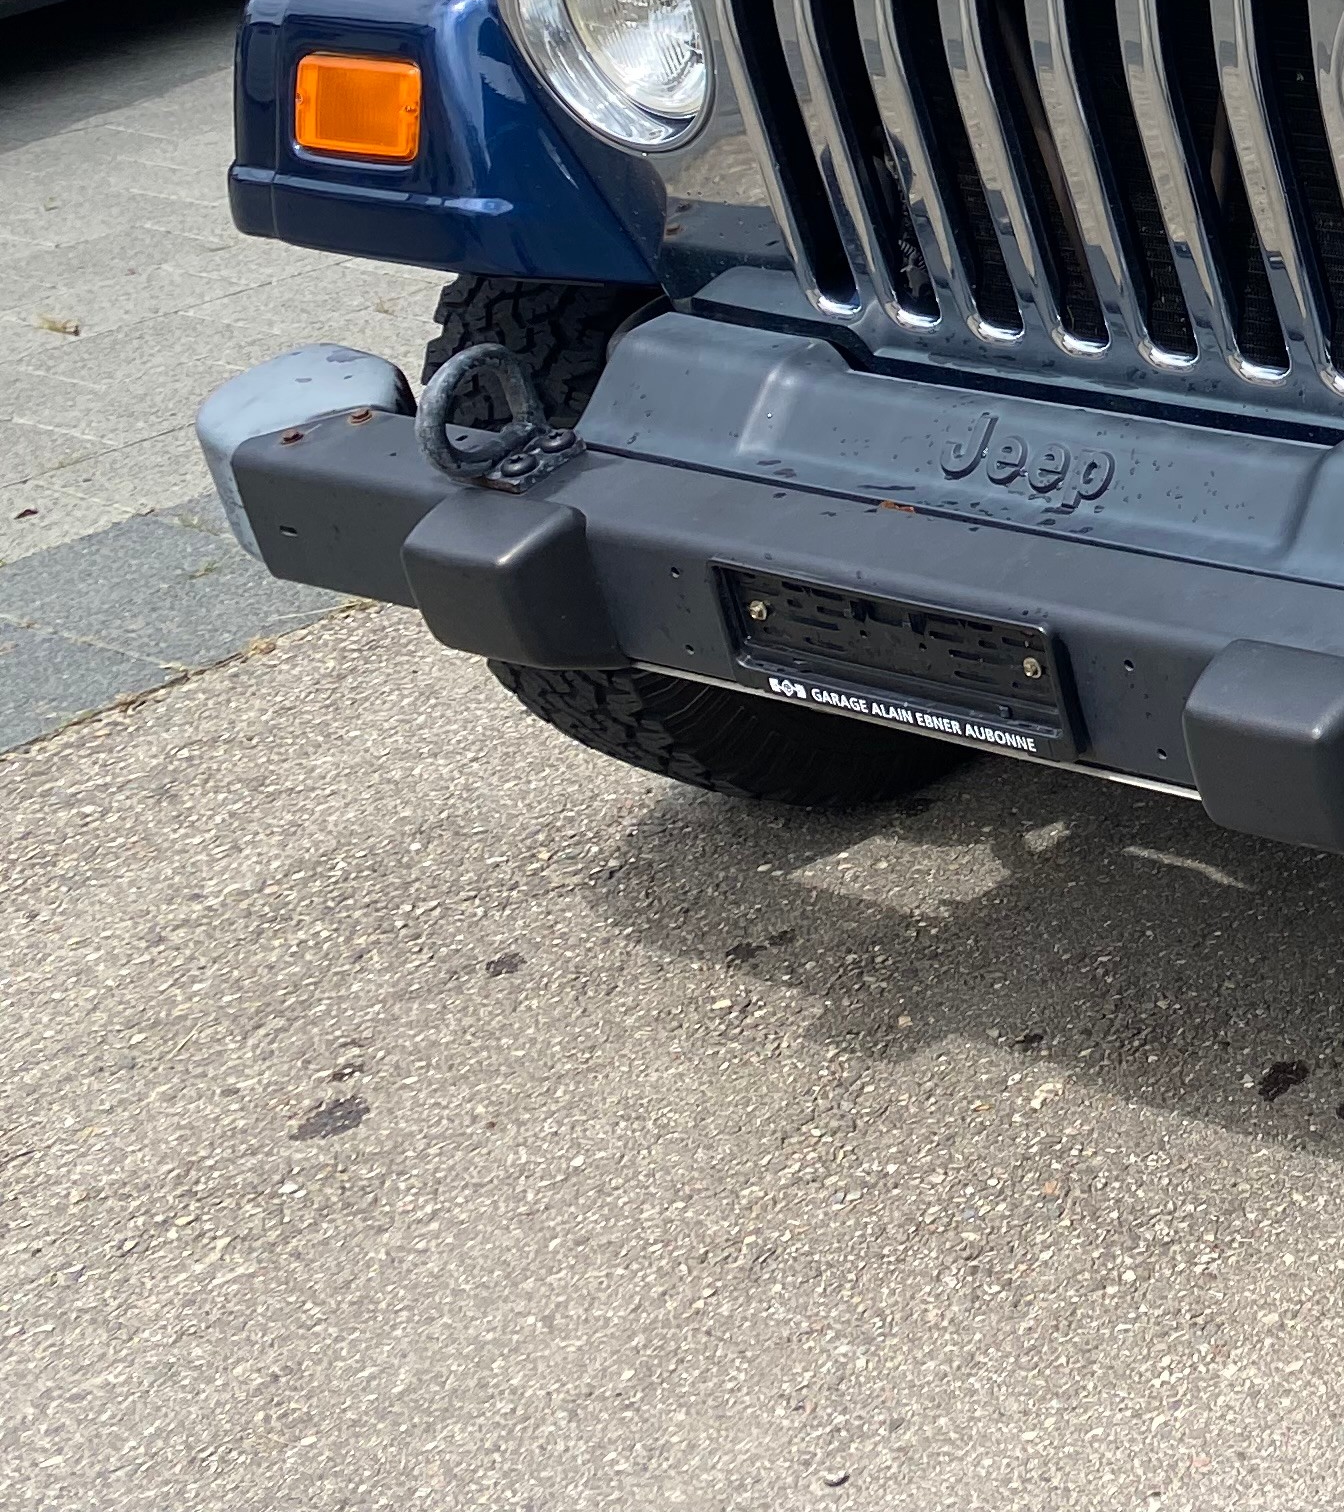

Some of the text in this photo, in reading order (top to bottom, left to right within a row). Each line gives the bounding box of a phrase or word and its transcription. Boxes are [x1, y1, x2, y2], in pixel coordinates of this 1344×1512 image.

[939, 411, 1116, 512] Jeep
[811, 688, 1037, 752] GARAGE ALAIN EBNER AUBONNE
